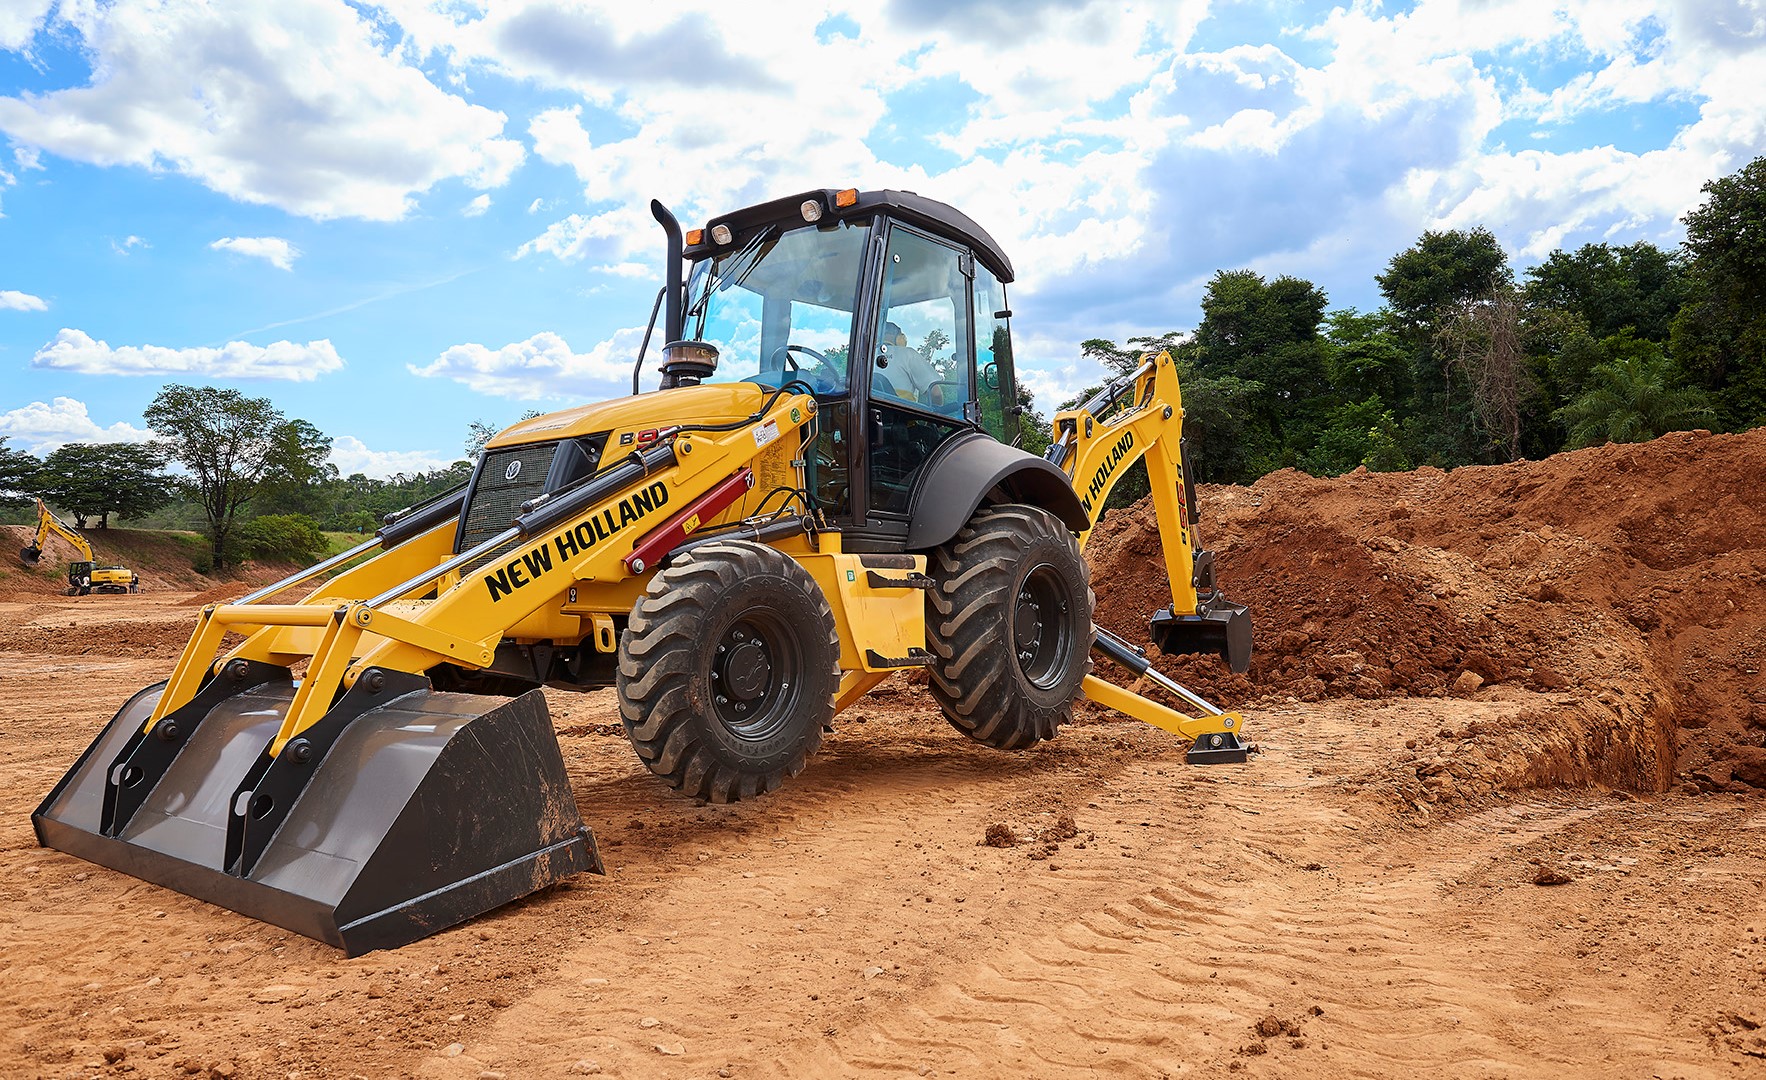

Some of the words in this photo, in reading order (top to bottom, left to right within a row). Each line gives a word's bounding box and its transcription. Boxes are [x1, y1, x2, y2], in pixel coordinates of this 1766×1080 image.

[1089, 431, 1134, 501] HOLLAND
[483, 544, 553, 603] NEW
[554, 481, 669, 562] HOLLAND
